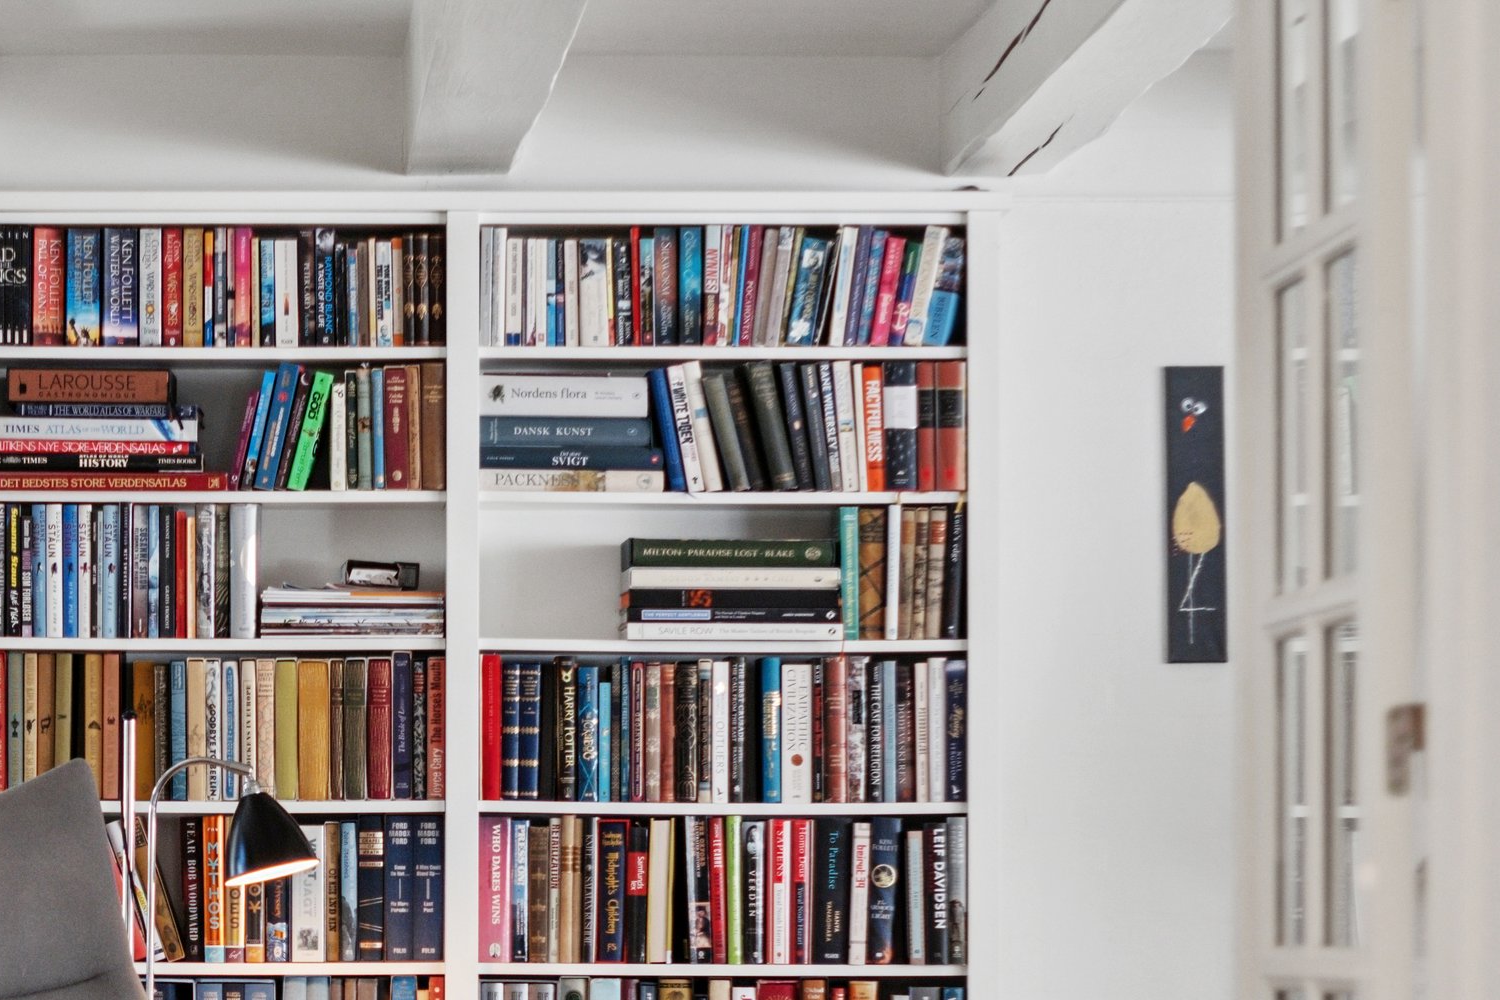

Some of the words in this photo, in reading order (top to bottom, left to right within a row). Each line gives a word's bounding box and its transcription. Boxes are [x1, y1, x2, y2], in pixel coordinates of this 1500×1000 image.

[38, 240, 47, 262] FALL
[50, 240, 61, 264] KEN
[83, 236, 94, 258] KEN
[110, 236, 119, 277] WINTER
[122, 239, 134, 264] KEN
[38, 266, 47, 280] OF
[706, 249, 717, 290] NYNNES
[50, 268, 61, 321] FOLLETT
[83, 263, 94, 311] FOLLETT
[122, 267, 134, 322] FOLLETT
[318, 291, 324, 300] OF
[38, 283, 47, 321] GIANTS
[110, 288, 119, 327] WORLD
[318, 302, 324, 312] MY
[741, 280, 754, 339] POCAHONTAS
[38, 375, 136, 391] LAROUSSE
[820, 365, 831, 392] RANE
[308, 392, 320, 419] GOD
[511, 388, 557, 399] Nordens
[561, 388, 586, 399] flora
[54, 407, 68, 416] THE
[70, 407, 100, 416] WORLD
[101, 407, 122, 416] ATLAS
[124, 407, 132, 416] OF
[134, 407, 166, 416] WARFARE
[823, 394, 838, 450] WILLERSLEV
[866, 380, 882, 461] FACTFULNESS
[4, 424, 40, 434] TIMES
[45, 424, 81, 434] ATLAS
[102, 424, 144, 434] WORLD
[514, 427, 550, 436] DANSK
[556, 427, 593, 436] KUNST
[38, 441, 58, 453] NYE
[79, 458, 128, 468] HISTORY
[552, 456, 588, 466] SVIGT
[1, 478, 19, 488] DET
[23, 478, 68, 488] BEDSTES
[71, 478, 105, 488] STORE
[109, 478, 186, 488] VERDENSATLAS
[495, 474, 579, 486] PACKNESS
[22, 550, 30, 570] MORD
[643, 548, 681, 557] MILTON
[688, 548, 733, 557] PARADISE
[735, 548, 757, 557] LOST
[765, 548, 795, 557] BLAKE
[22, 572, 30, 584] SOM
[430, 662, 442, 690] Mouth
[564, 686, 575, 722] HARRY
[871, 684, 881, 700] THE
[787, 669, 796, 750] CIVILIZATION
[797, 686, 808, 751] EMPATHIC
[871, 702, 881, 722] CASE
[209, 704, 217, 747] GOODBYE
[430, 722, 442, 743] The
[582, 718, 596, 760] ICKABOG
[871, 724, 881, 741] FOR
[209, 749, 217, 758] TO
[564, 727, 575, 766] POTTER
[716, 721, 725, 774] OUTLIERS
[432, 749, 442, 773] Cary
[871, 744, 881, 784] RELIGION
[209, 763, 217, 796] BERLIN
[432, 774, 442, 797] Joyce
[187, 822, 199, 853] FEAR
[491, 824, 500, 852] WHO
[714, 840, 722, 848] LE
[829, 831, 838, 843] To
[934, 829, 945, 856] LEIF
[187, 859, 199, 879] BOB
[551, 824, 560, 889] RETAILIZATION
[829, 847, 838, 889] Paradise
[491, 856, 500, 890] DARES
[606, 853, 619, 895] Midnight's
[934, 862, 945, 929] DAVIDSEN
[187, 883, 199, 941] WOODWARD
[491, 895, 500, 924] WINS
[606, 900, 619, 934] Children
